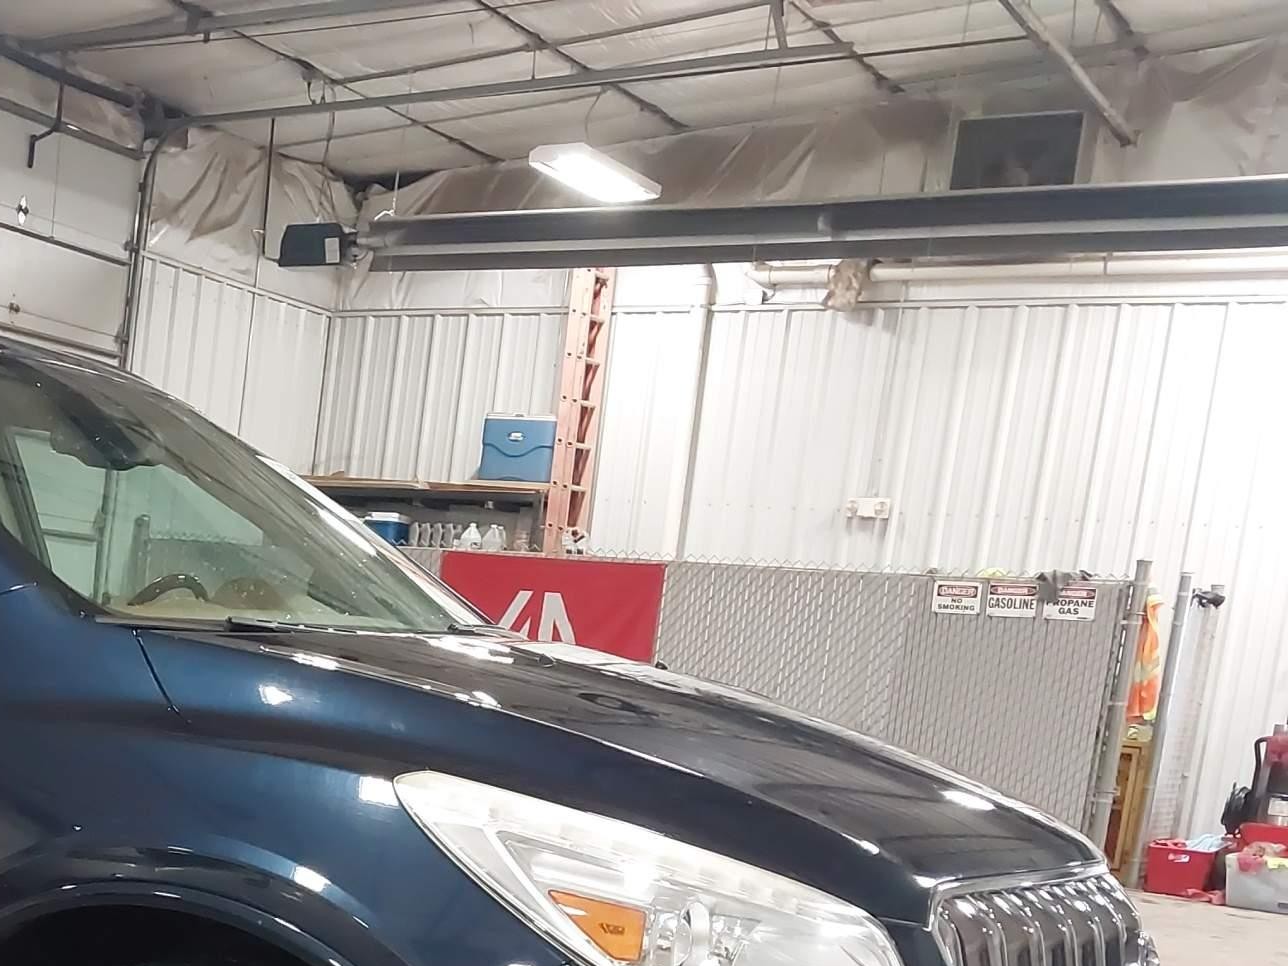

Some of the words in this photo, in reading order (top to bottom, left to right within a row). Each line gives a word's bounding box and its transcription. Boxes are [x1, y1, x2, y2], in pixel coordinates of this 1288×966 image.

[937, 603, 975, 611] SMOKING
[988, 597, 1035, 610] GASOLINE
[1058, 607, 1079, 615] GAS
